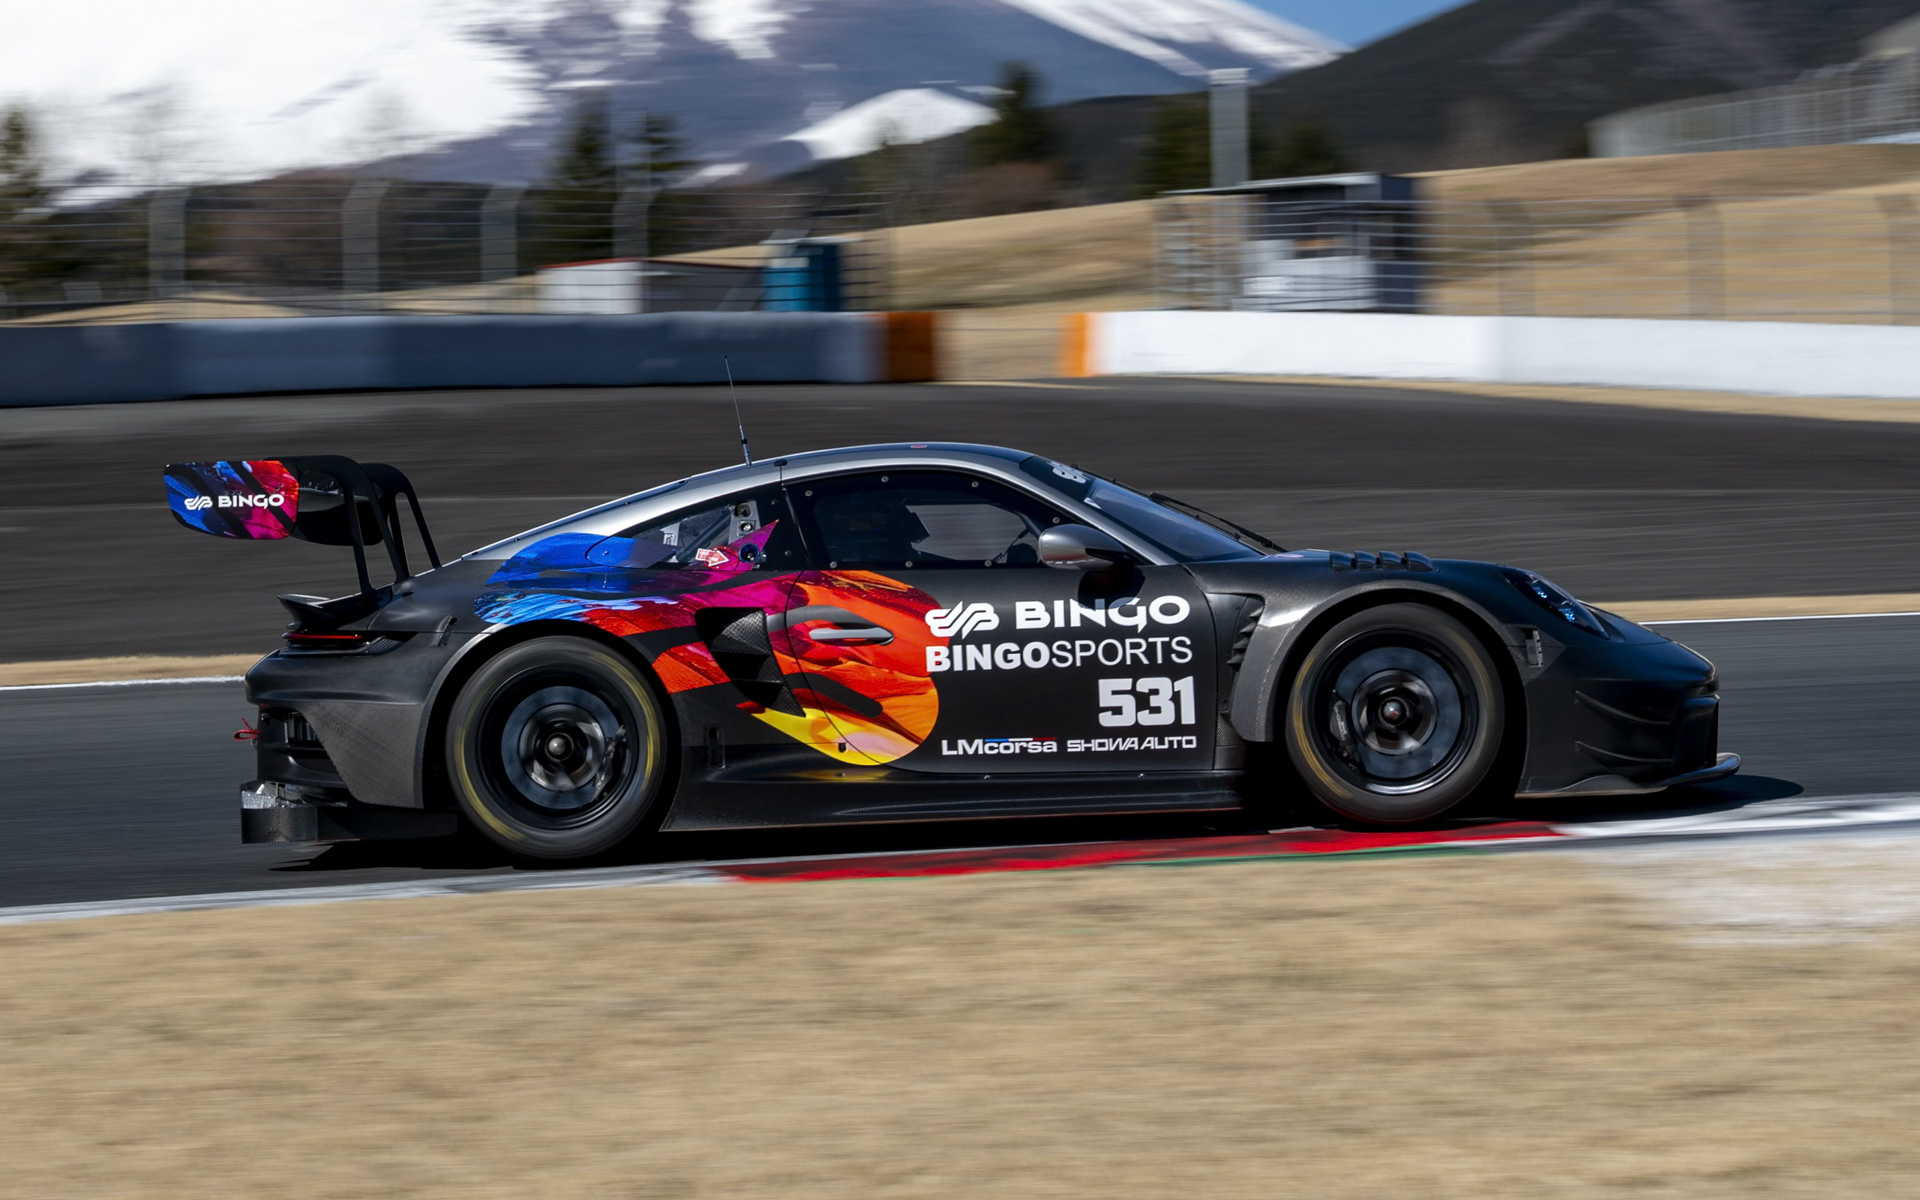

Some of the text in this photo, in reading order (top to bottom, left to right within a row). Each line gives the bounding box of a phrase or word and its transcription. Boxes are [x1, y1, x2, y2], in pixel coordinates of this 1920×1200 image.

[218, 494, 285, 508] BINGO
[1015, 595, 1190, 633] BINGO
[925, 636, 1193, 672] BINGOSPORTS
[1098, 676, 1196, 727] 531
[941, 738, 1058, 756] LMcorsa
[1066, 735, 1197, 752] SHOWA AUTO
